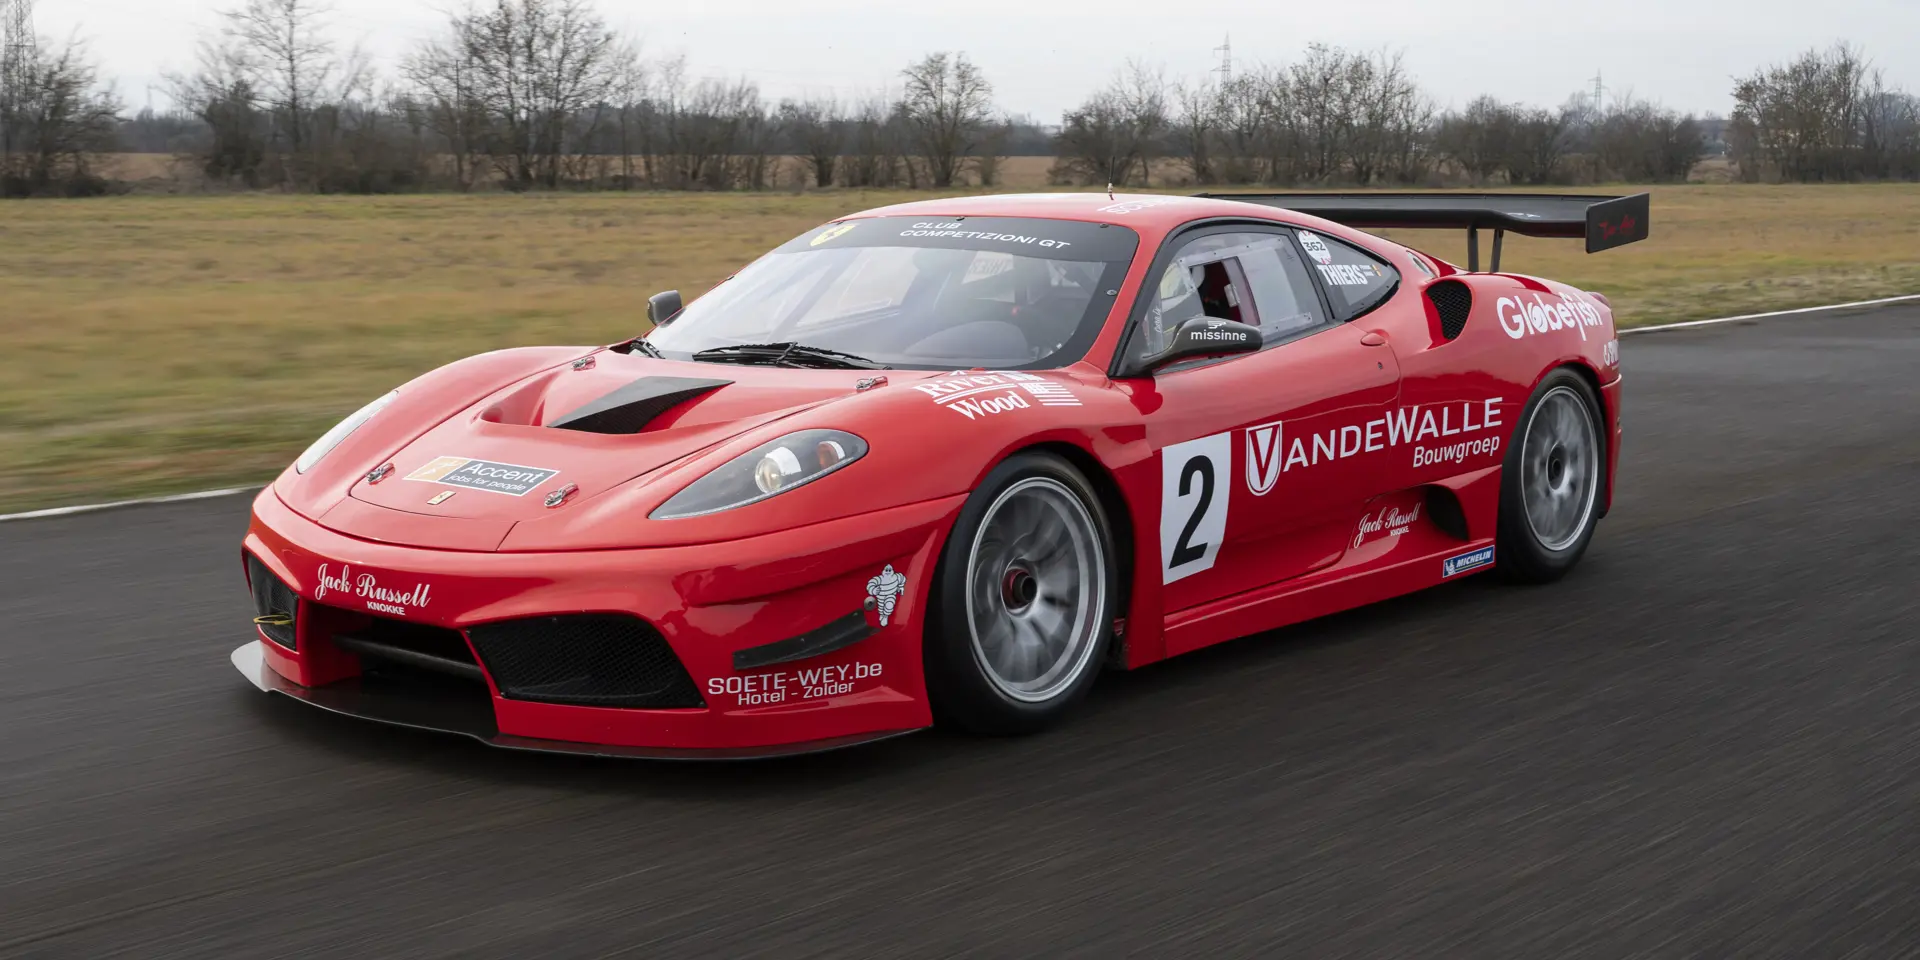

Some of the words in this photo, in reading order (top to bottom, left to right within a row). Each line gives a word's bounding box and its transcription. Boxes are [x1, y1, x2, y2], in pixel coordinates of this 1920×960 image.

[900, 229, 1036, 244] COMPETIZIONI
[1039, 239, 1071, 249] GT
[1303, 242, 1326, 251] 362
[1317, 264, 1368, 286] THIERS
[1496, 293, 1603, 341] Globefish
[1190, 329, 1247, 341] missinne
[912, 374, 1005, 398] River
[947, 390, 1031, 420] Wood
[1413, 435, 1500, 468] Bouwgroep
[445, 474, 470, 483] jobs
[487, 479, 526, 491] people
[460, 463, 545, 483] Accent
[1168, 454, 1215, 570] 2
[1353, 506, 1387, 548] Jack
[1385, 502, 1422, 529] Russell
[1390, 525, 1410, 537] KNOKKE
[1456, 550, 1492, 568] MICHELIN
[315, 563, 352, 600] Jack
[355, 573, 431, 607] Russell
[366, 601, 406, 616] KNOKKE
[708, 662, 882, 695] SOETE-WEY.be
[738, 689, 785, 706] Hotel
[803, 680, 855, 699] Zolder
